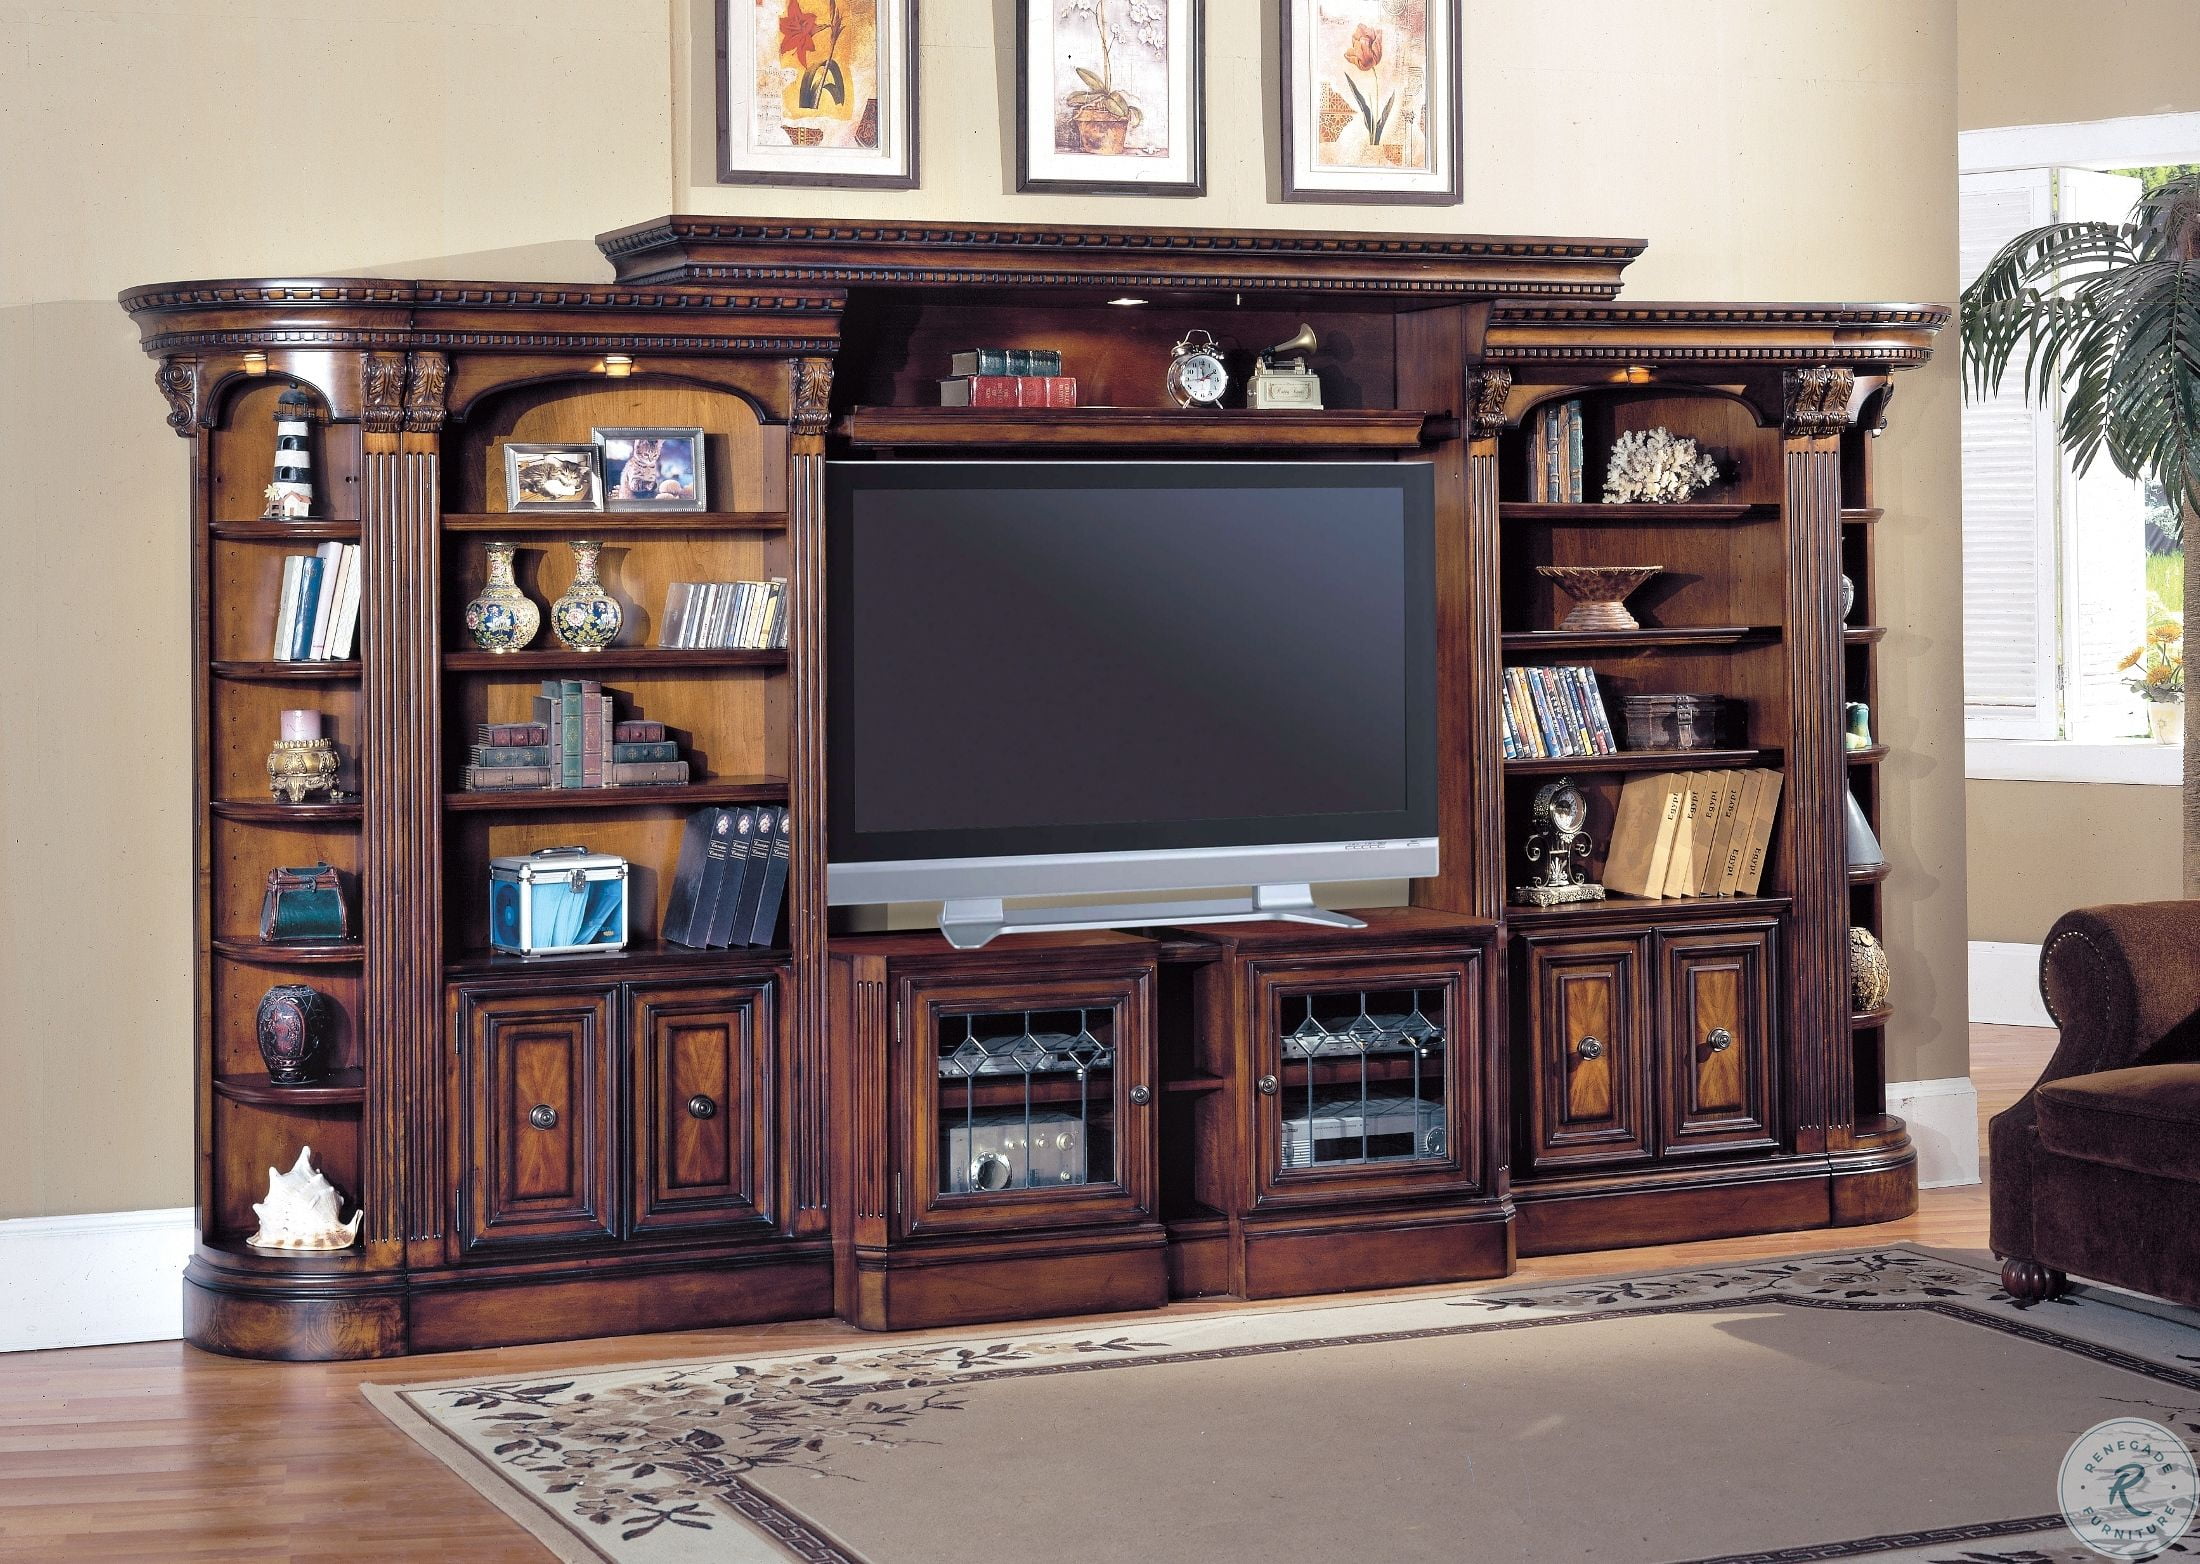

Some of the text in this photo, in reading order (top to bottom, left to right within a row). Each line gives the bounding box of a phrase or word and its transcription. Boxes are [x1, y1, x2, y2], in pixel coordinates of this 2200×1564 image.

[1667, 791, 1679, 820] Egypt
[1687, 791, 1699, 819] Egypt
[1705, 790, 1718, 818] Egypt
[1725, 789, 1737, 818] Egypt
[1727, 848, 1739, 876] Egypt
[1749, 847, 1762, 876] Egypt
